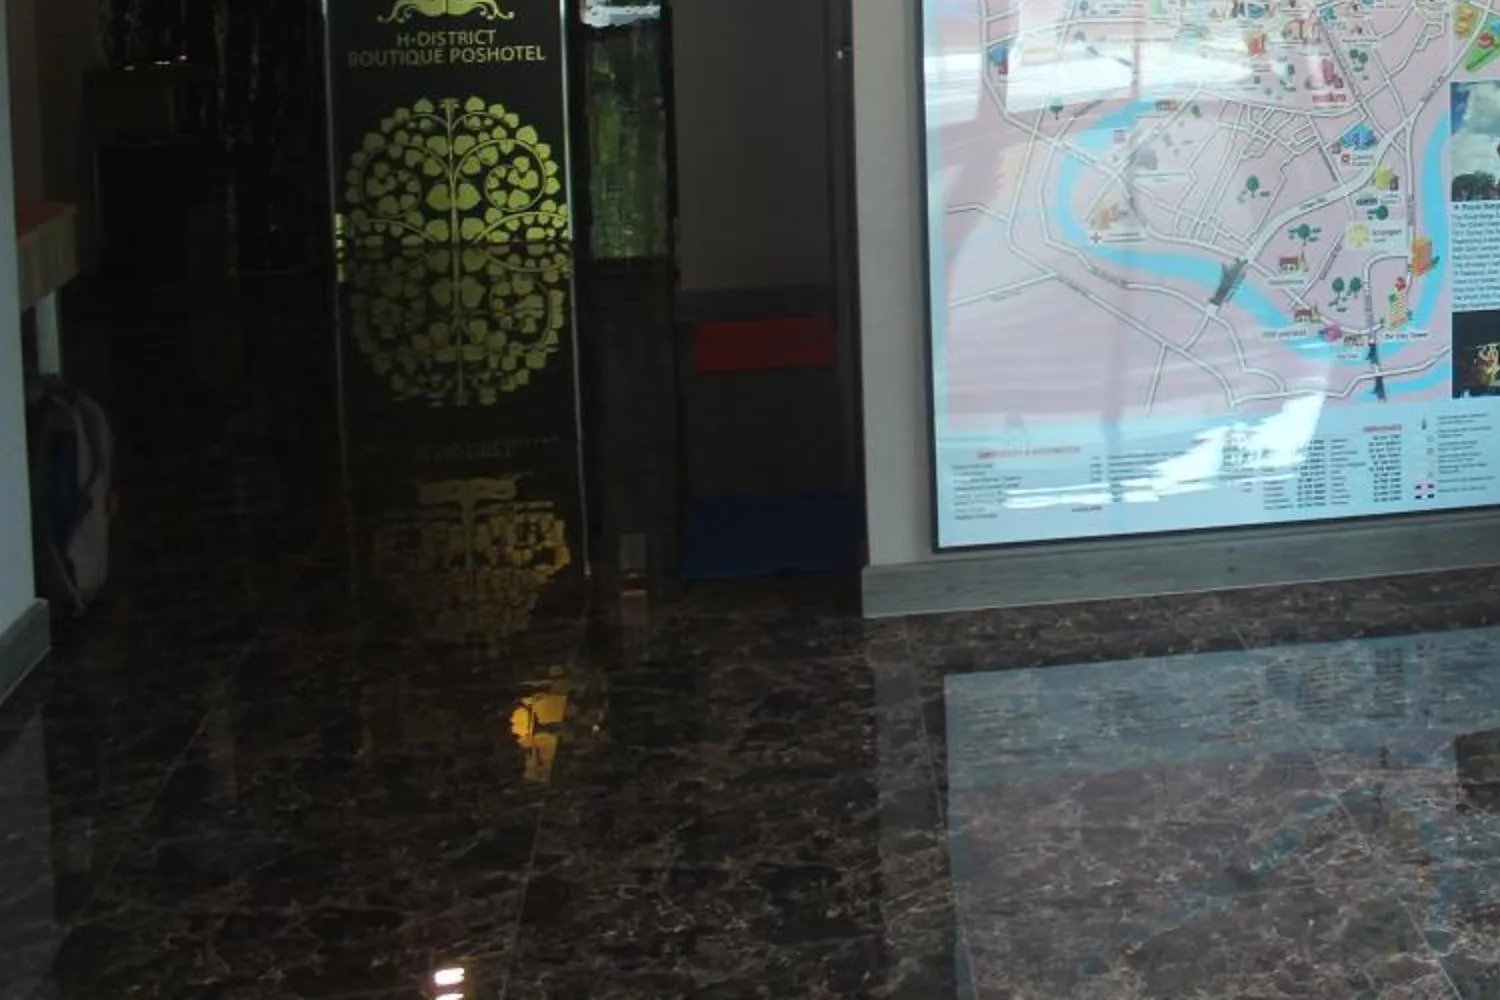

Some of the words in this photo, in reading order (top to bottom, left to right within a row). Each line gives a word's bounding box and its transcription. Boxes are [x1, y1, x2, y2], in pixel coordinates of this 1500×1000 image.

[396, 29, 497, 47] H-DISTRICT
[348, 46, 444, 68] BOUTIQUE
[449, 44, 547, 64] POSHOTEL
